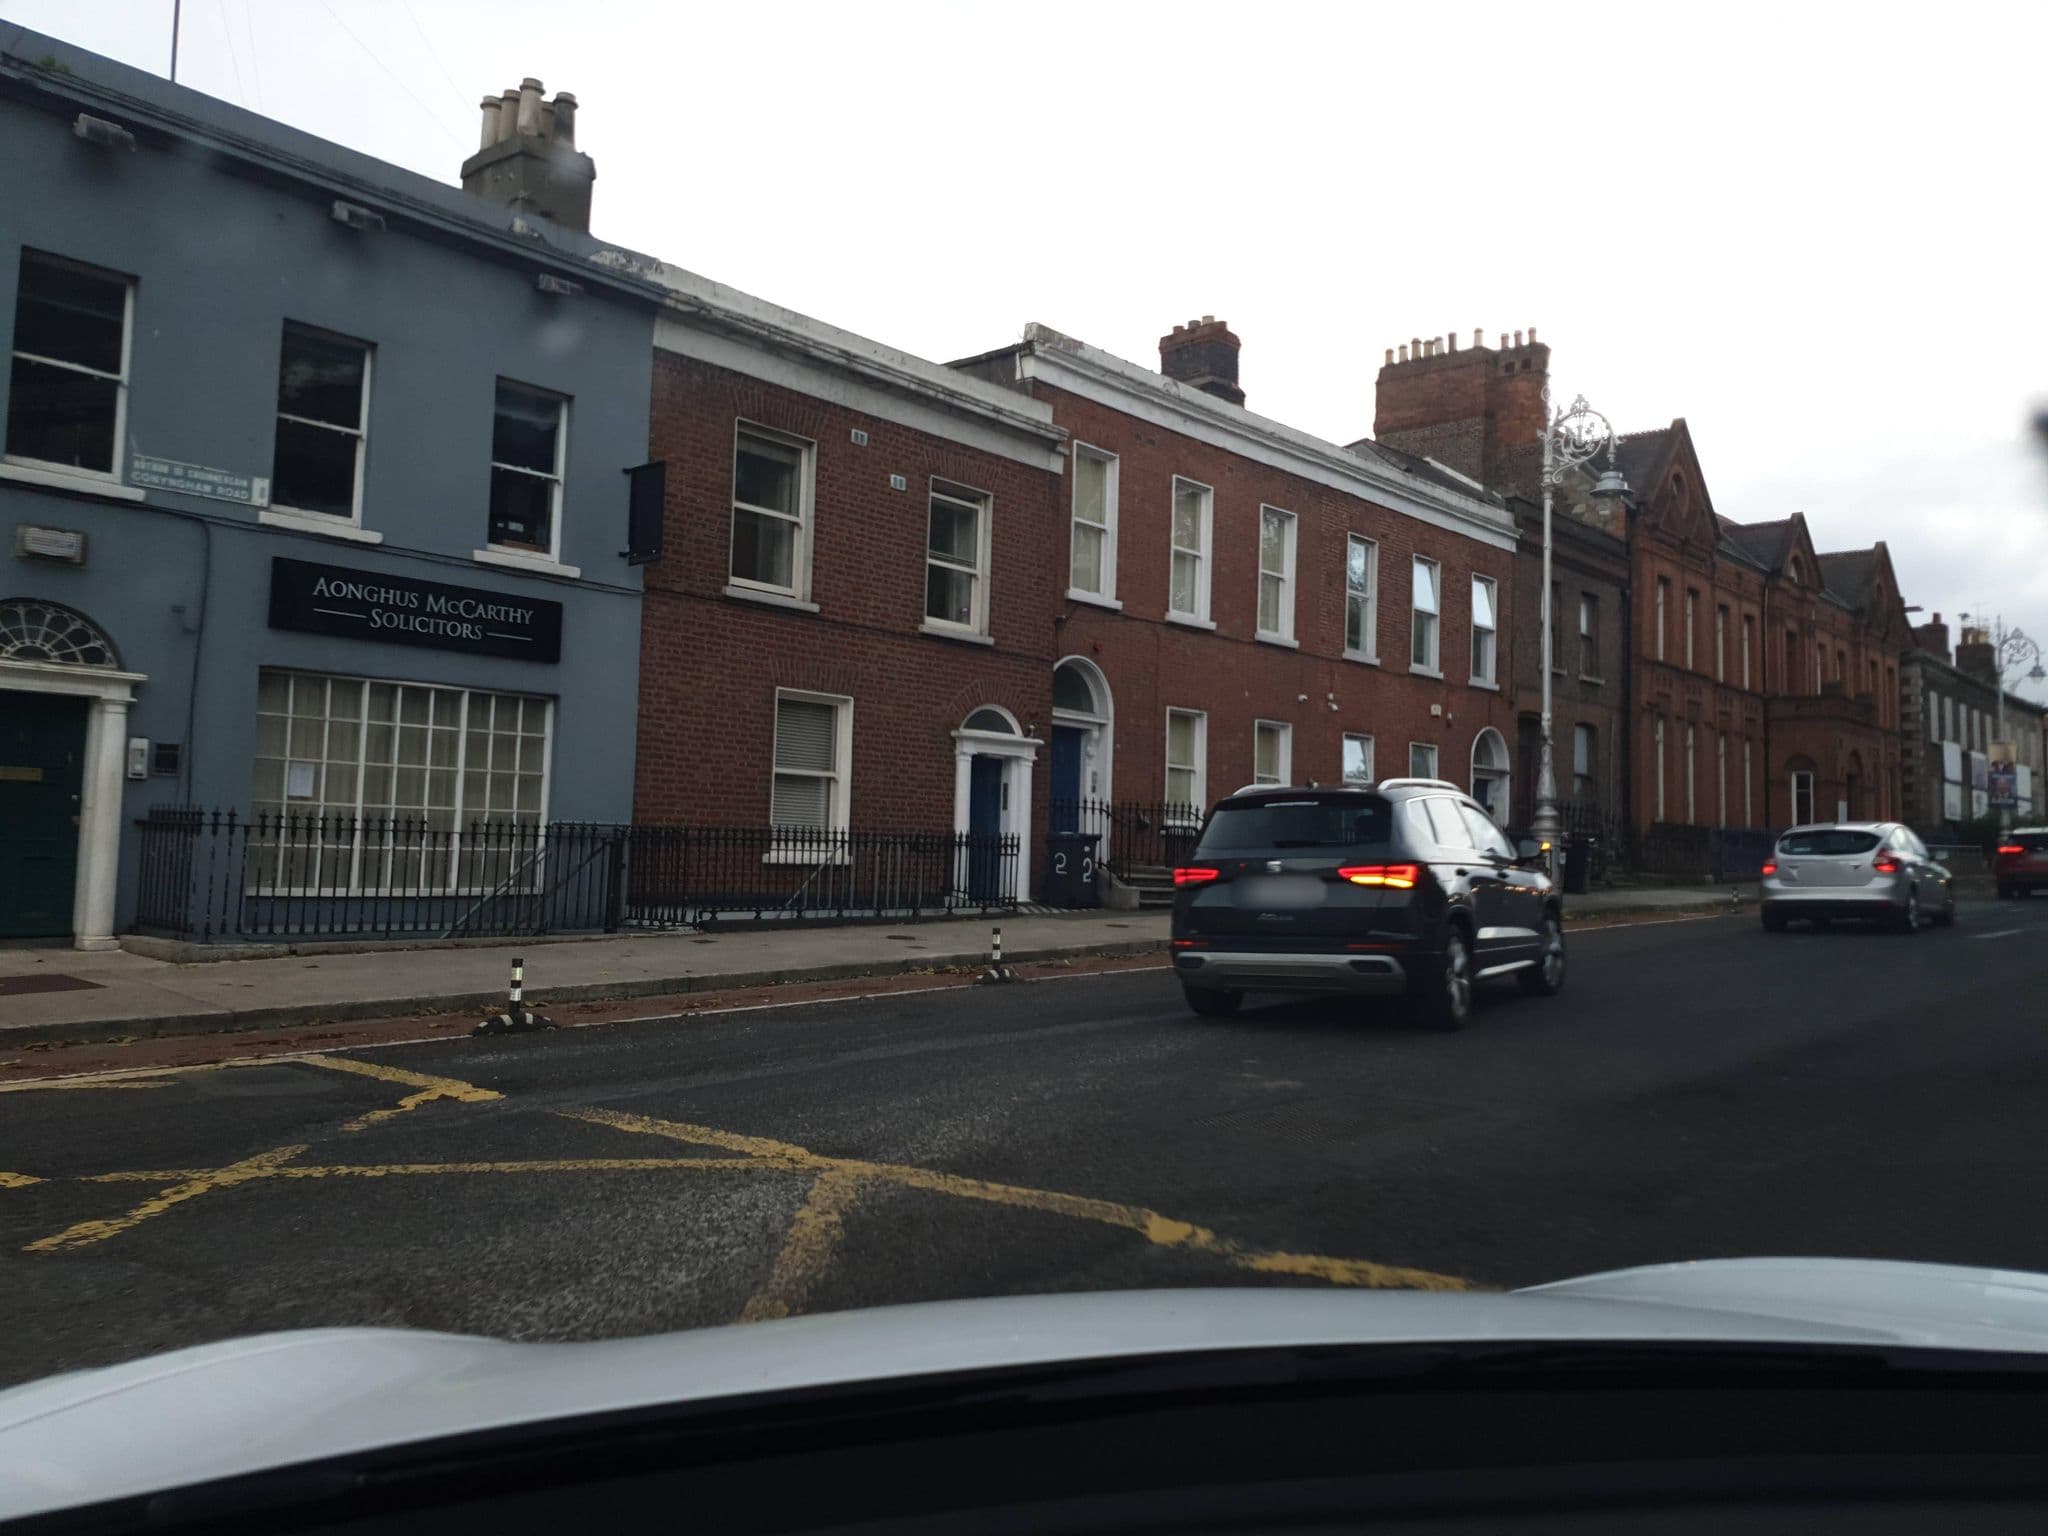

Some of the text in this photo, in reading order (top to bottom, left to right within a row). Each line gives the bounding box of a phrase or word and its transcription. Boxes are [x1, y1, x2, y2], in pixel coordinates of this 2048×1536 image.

[216, 484, 249, 500] ROAD
[312, 577, 419, 608] AONGHUS
[369, 609, 483, 640] SOLICITORS
[1054, 852, 1068, 875] 2
[1082, 857, 1093, 883] 2
